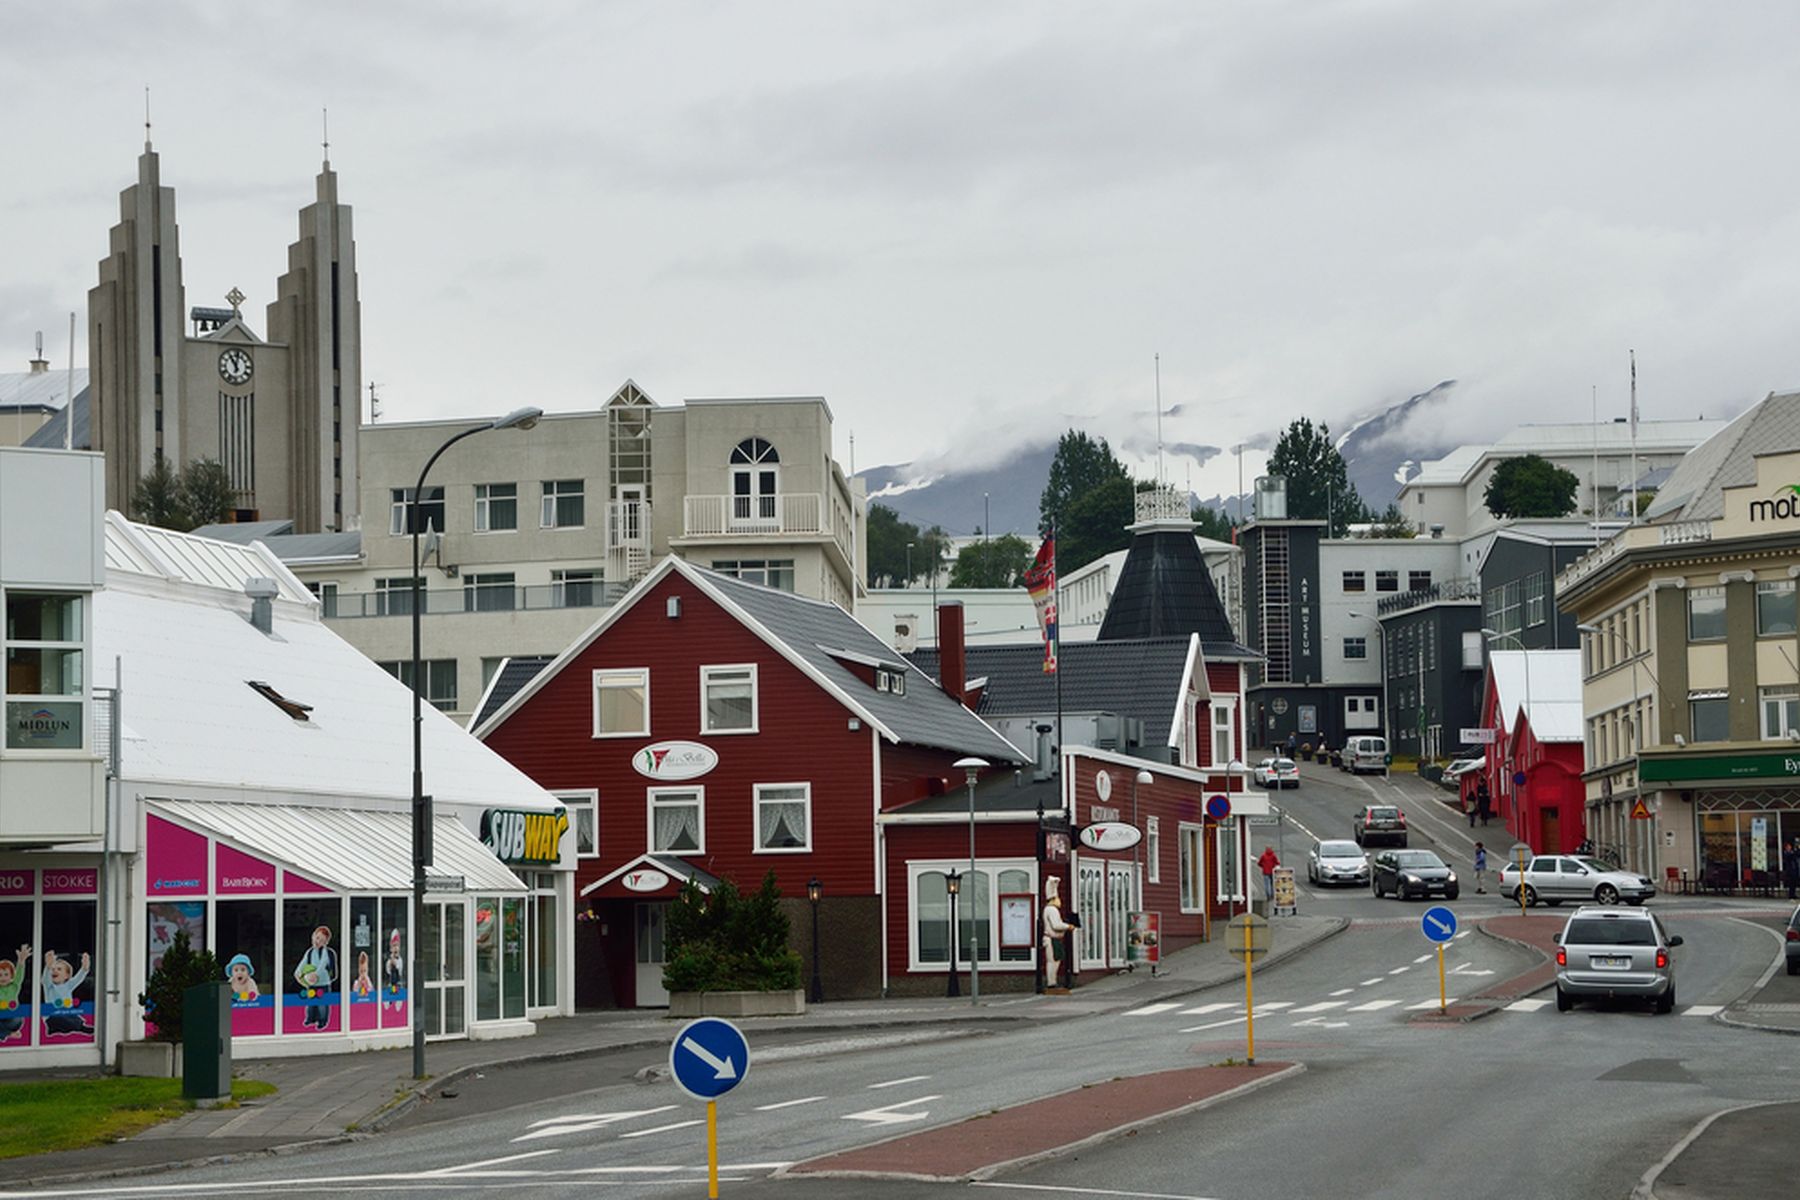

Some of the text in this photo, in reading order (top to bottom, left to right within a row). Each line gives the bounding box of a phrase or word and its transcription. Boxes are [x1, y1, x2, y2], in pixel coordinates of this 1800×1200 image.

[1300, 578, 1310, 656] ART MUSEUM
[484, 811, 569, 860] SUBWAY
[43, 875, 95, 888] STOKKE
